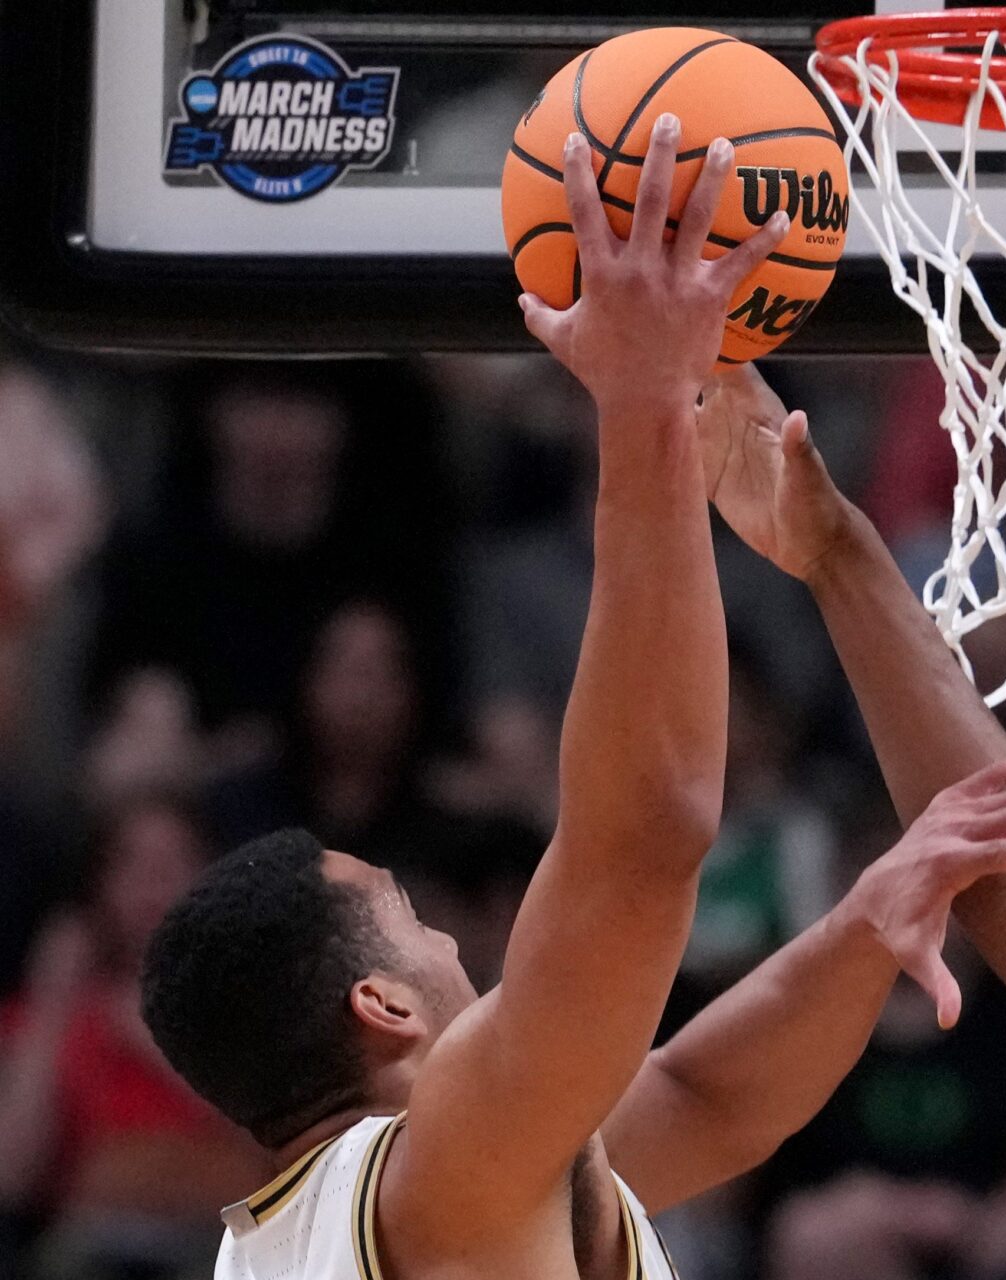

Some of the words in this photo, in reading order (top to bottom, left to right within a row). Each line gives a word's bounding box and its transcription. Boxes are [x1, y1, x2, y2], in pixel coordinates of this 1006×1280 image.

[218, 81, 335, 116] MARCH
[231, 117, 388, 151] MADNESS
[736, 166, 849, 234] Wilso
[806, 235, 825, 245] EVO
